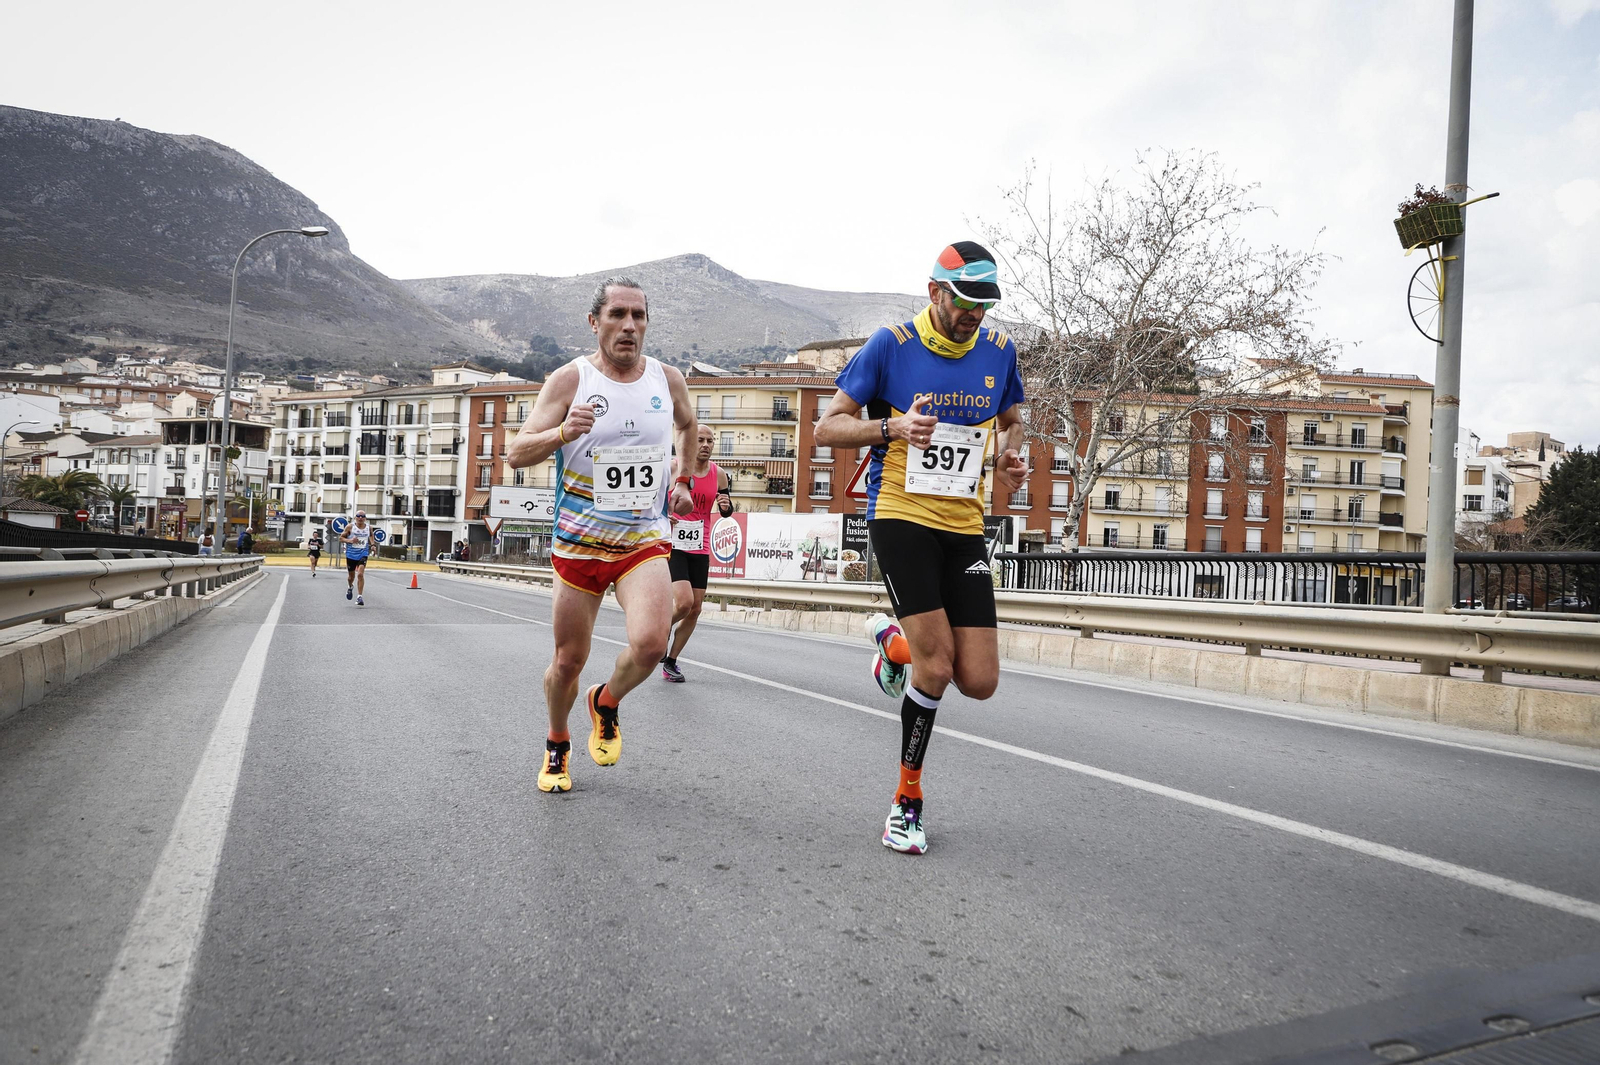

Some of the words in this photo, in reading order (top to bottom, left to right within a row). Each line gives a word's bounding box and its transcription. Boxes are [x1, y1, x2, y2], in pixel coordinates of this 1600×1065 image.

[913, 390, 991, 411] agustinos
[925, 409, 980, 419] GRANADA
[921, 445, 970, 473] 597
[606, 465, 654, 489] 913
[678, 529, 699, 541] 843
[714, 525, 738, 541] BURGER
[715, 533, 739, 552] KING
[747, 548, 794, 560] WHOPPER
